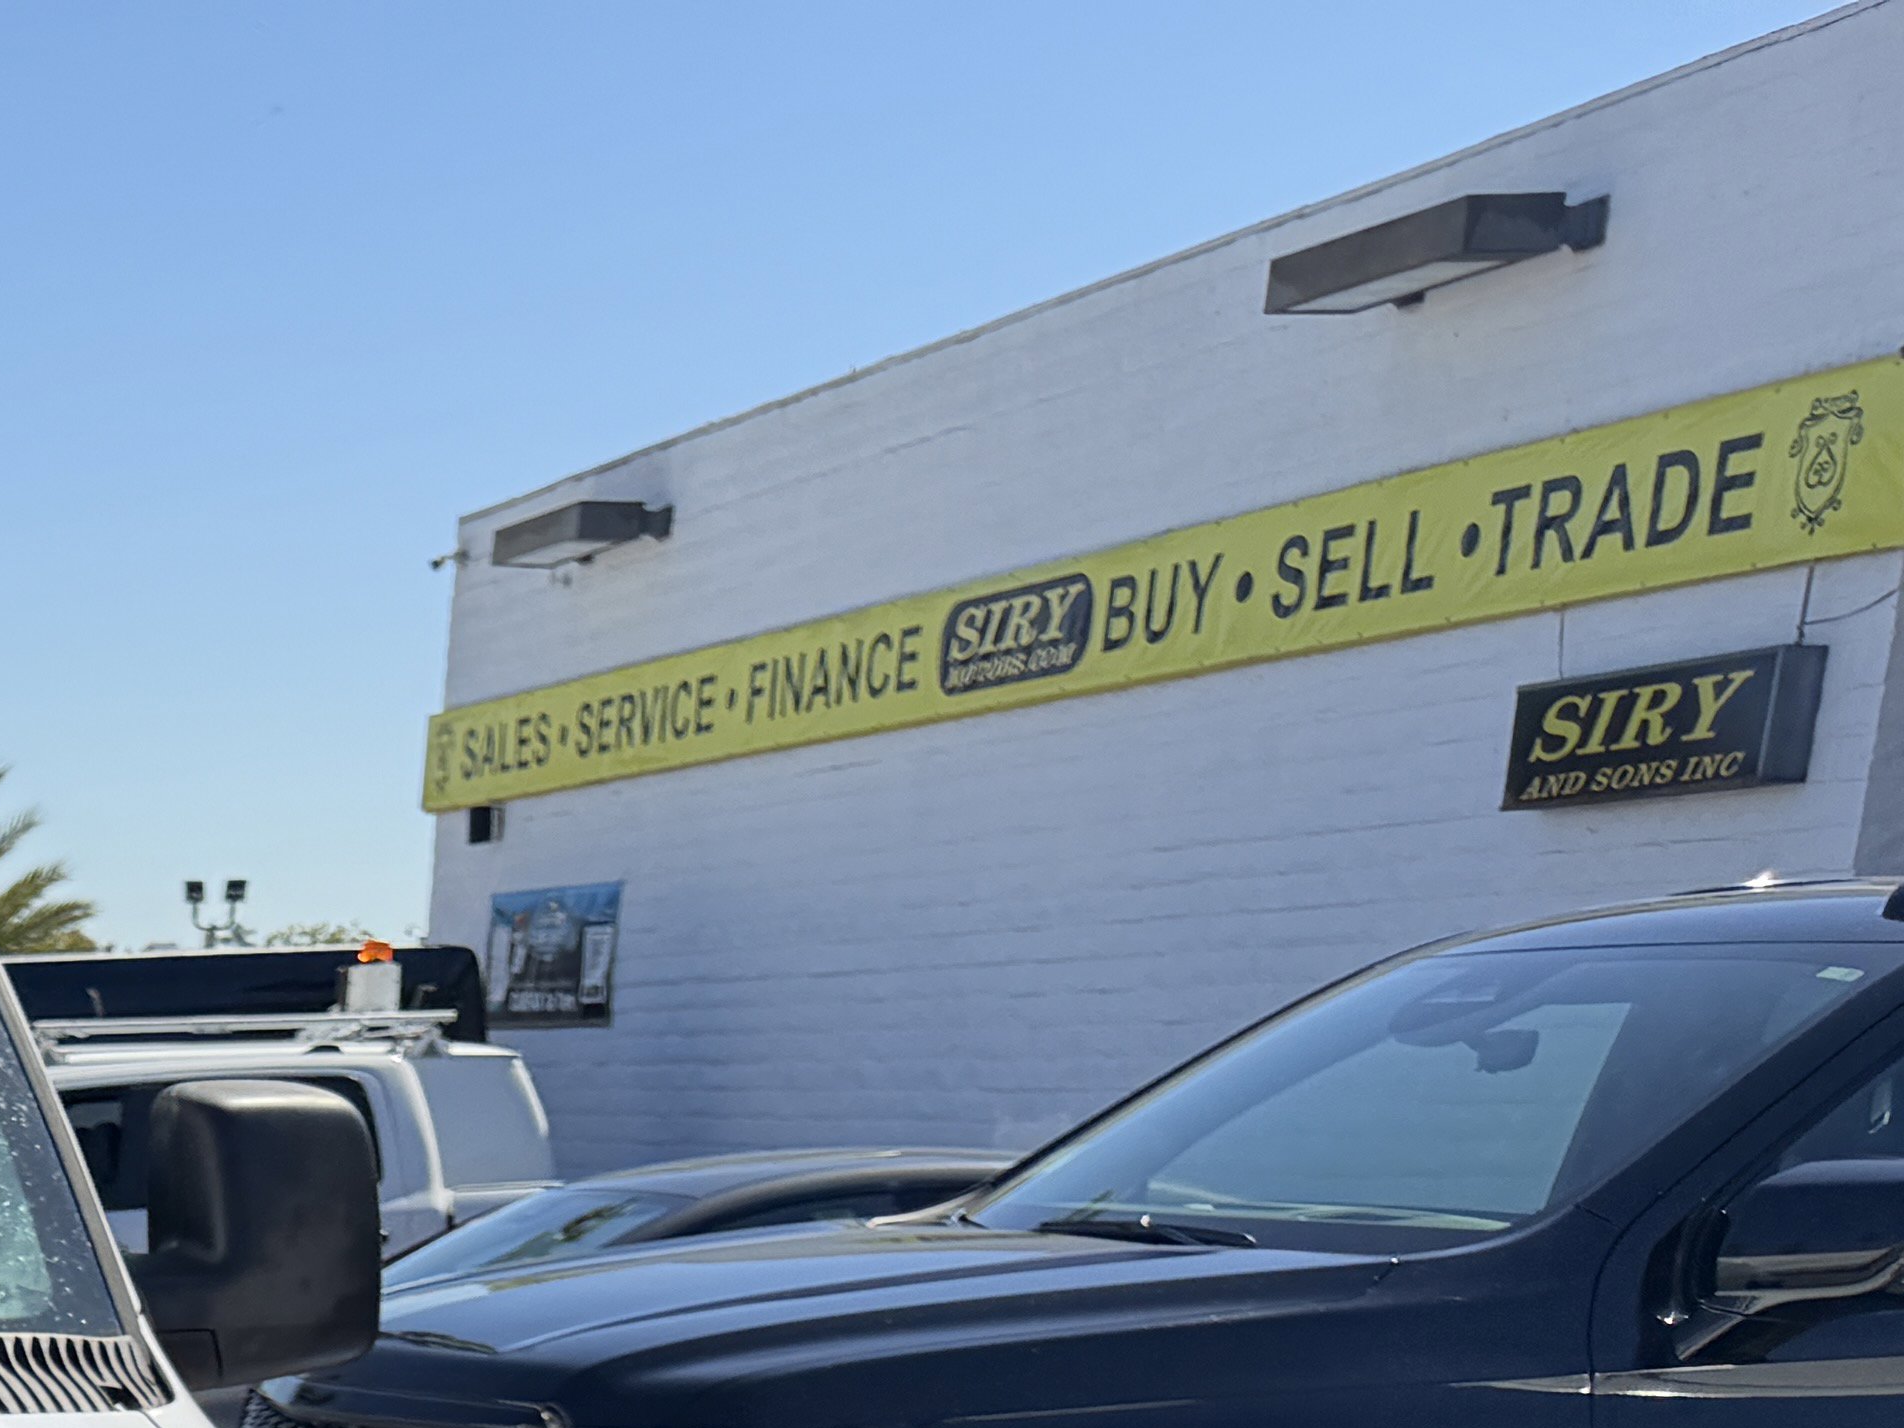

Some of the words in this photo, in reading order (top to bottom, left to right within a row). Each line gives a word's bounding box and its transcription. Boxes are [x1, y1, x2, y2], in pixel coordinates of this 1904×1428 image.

[1100, 552, 1225, 653] BUY
[1271, 510, 1435, 620] SELL
[1490, 432, 1764, 577] TRADE
[947, 582, 1086, 662] SIRY
[459, 712, 552, 781] SALES
[575, 675, 718, 759] SERVICE
[746, 625, 923, 725] FINANCE
[1527, 668, 1756, 764] SIRY
[1519, 771, 1587, 801] AND
[1591, 759, 1678, 793] SONS
[1679, 751, 1746, 782] INC
